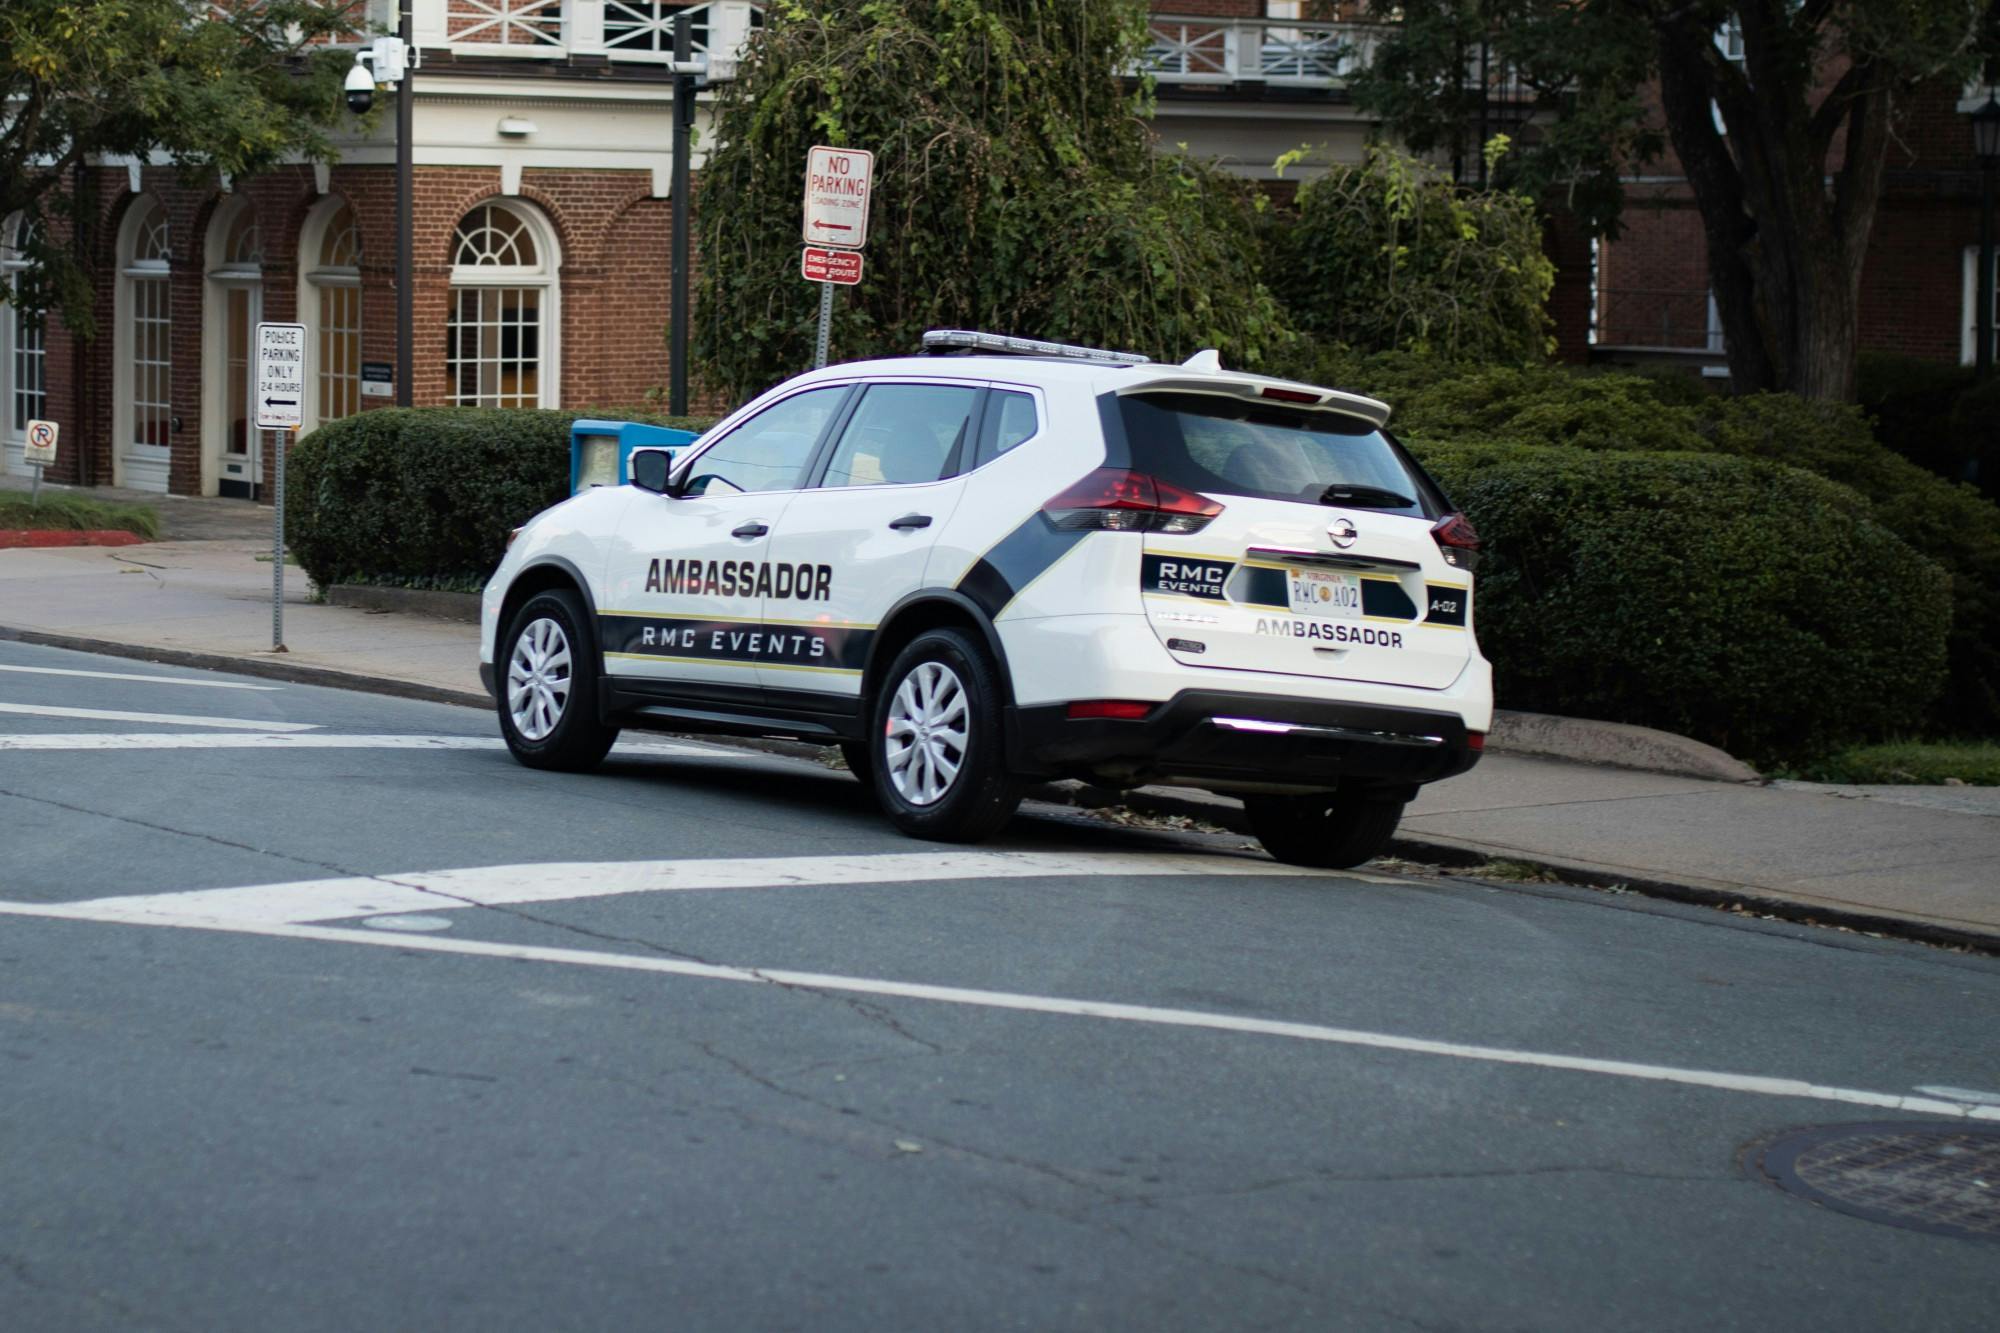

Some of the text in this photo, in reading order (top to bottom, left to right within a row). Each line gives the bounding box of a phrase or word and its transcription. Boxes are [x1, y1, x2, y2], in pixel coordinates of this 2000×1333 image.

[828, 156, 850, 175] NO
[811, 174, 865, 197] PARKING
[807, 254, 857, 267] EMERGENCY
[828, 267, 857, 278] ROUTE
[264, 330, 296, 345] POLICE
[262, 347, 300, 362] PARKING
[267, 365, 294, 379] ONLY
[260, 381, 301, 393] 24 HOURS
[645, 558, 832, 601] AMBASSADOR
[1159, 562, 1224, 583] RMC
[1158, 580, 1221, 594] EVENTS
[1333, 584, 1358, 608] A02
[1430, 600, 1457, 613] A-02
[1255, 618, 1403, 649] AMBASSADOR
[641, 626, 825, 657] RMC EVENTS
